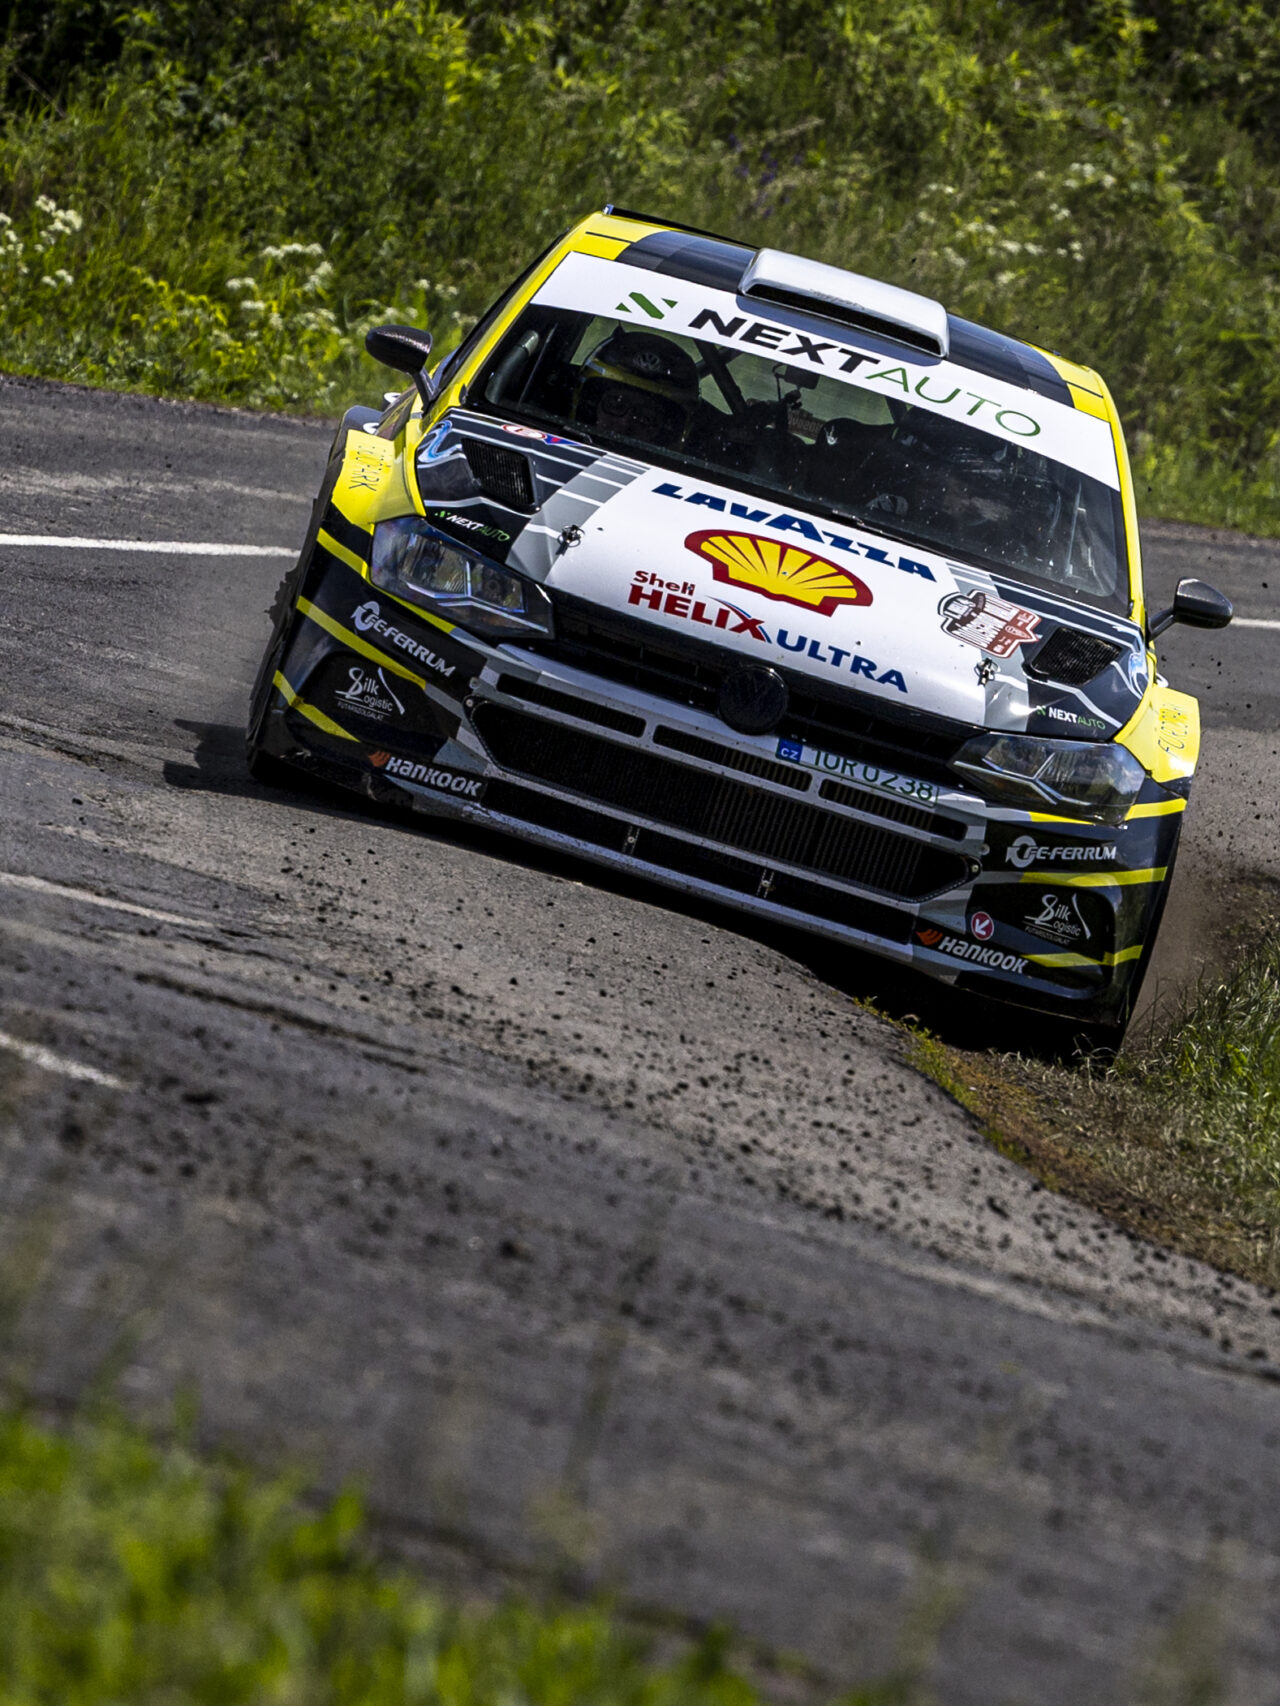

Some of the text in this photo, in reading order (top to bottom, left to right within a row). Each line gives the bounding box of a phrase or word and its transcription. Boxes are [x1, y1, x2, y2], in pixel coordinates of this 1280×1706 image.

[651, 483, 937, 583] LAVAZZA
[632, 570, 696, 596] Shell
[627, 583, 909, 694] HELIX ULTRA
[780, 747, 799, 760] CZ
